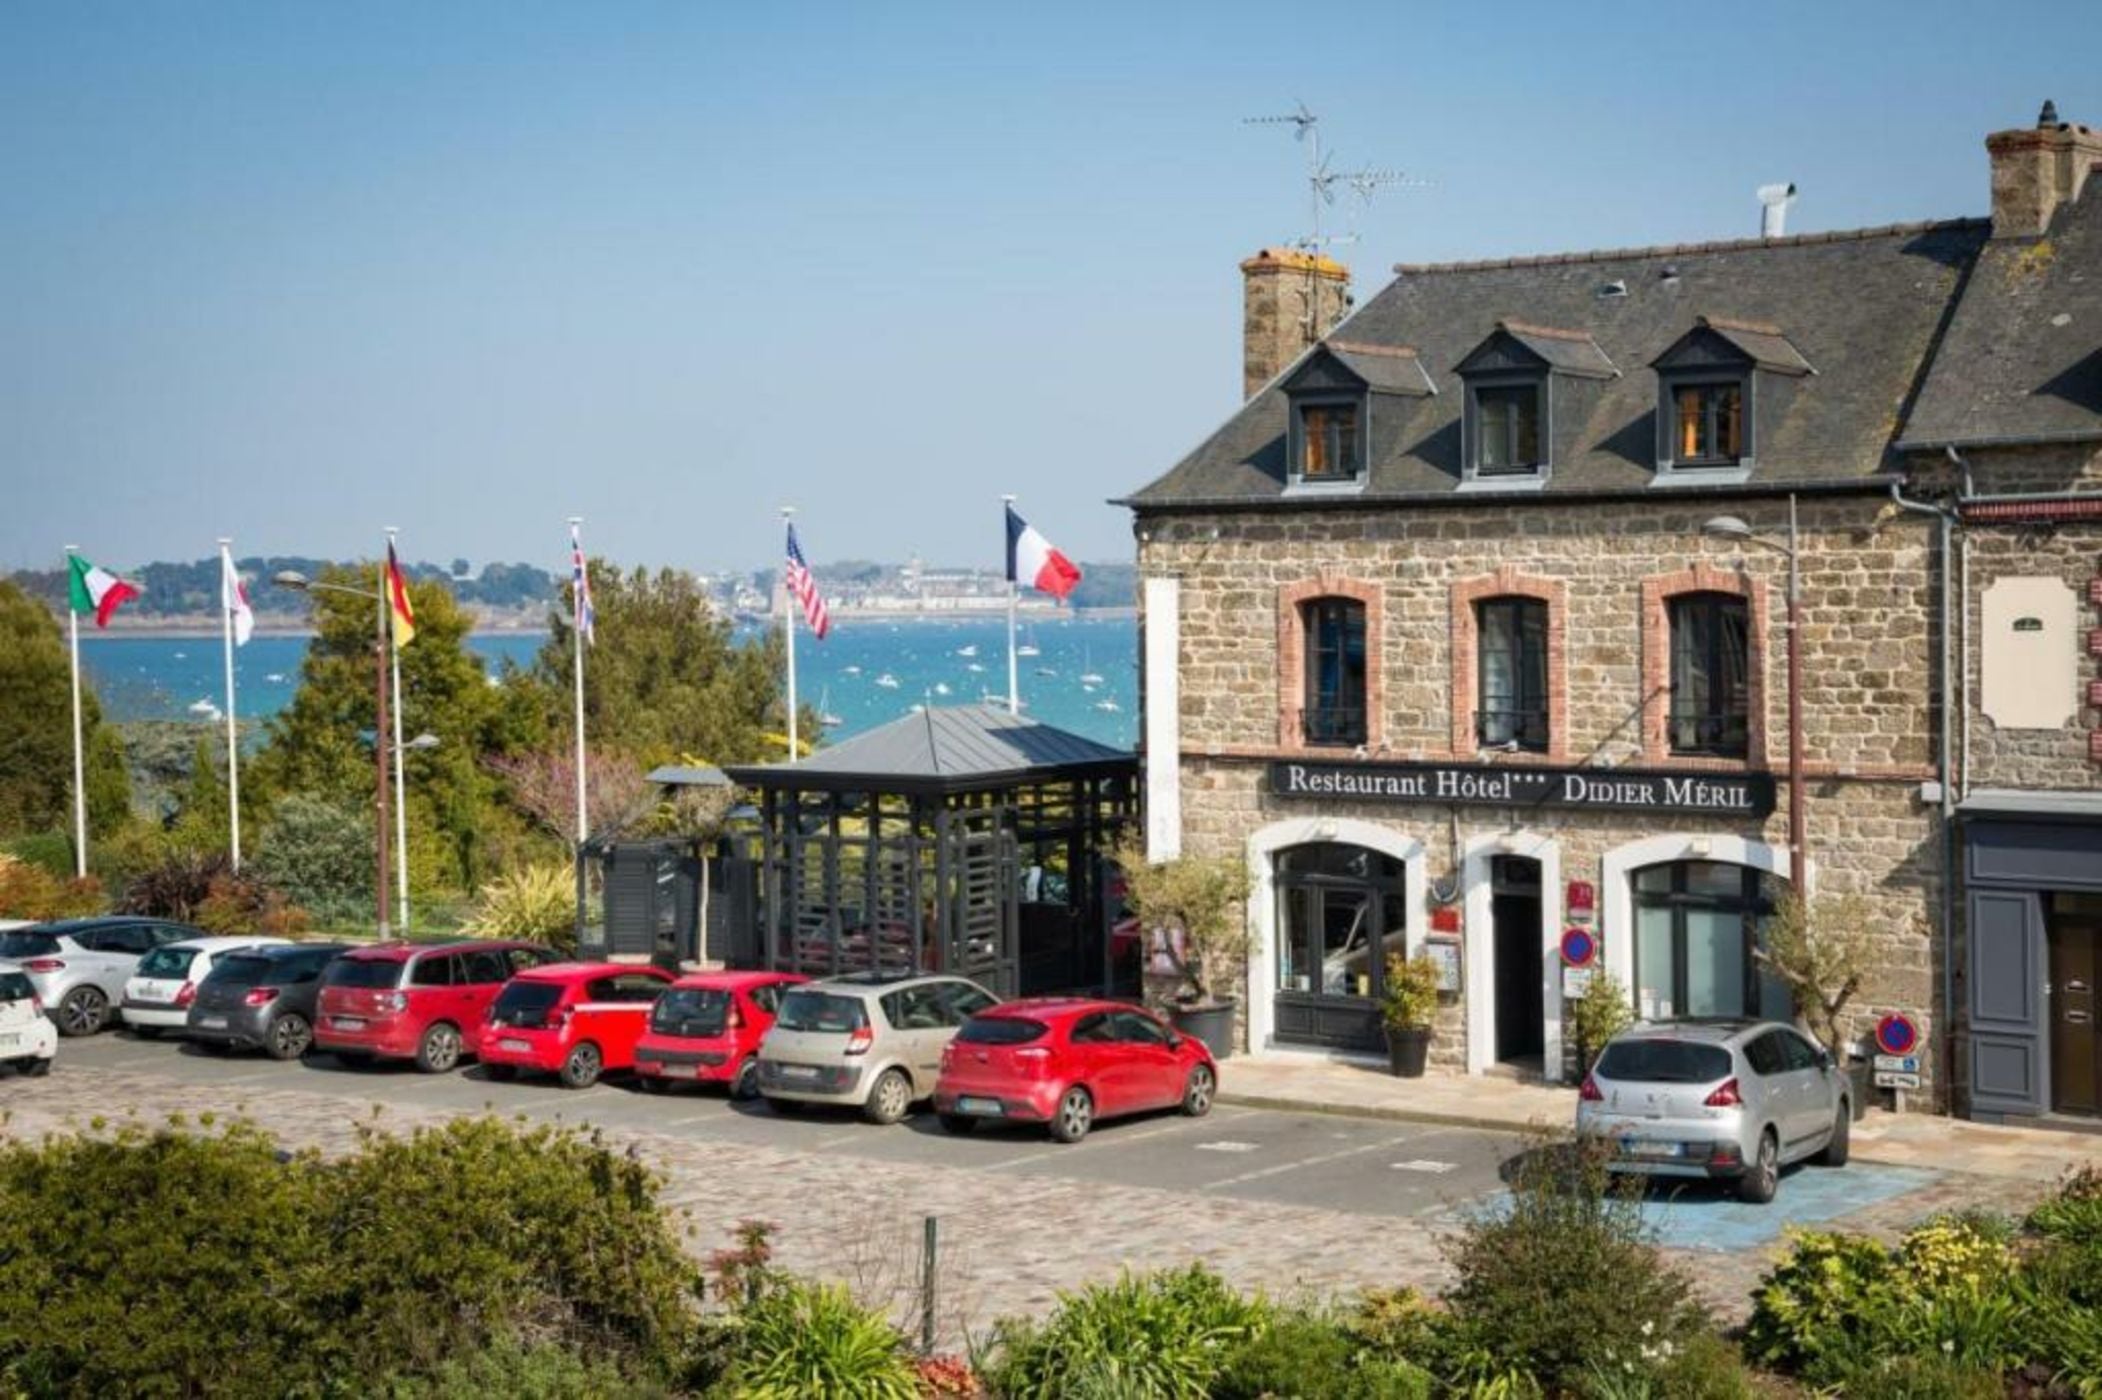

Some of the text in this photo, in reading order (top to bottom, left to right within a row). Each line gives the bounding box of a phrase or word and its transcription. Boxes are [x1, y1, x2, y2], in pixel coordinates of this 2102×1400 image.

[1288, 765, 1427, 796] Restaurant
[1563, 774, 1655, 805] DIDIER
[1663, 777, 1754, 807] MÉRIL
